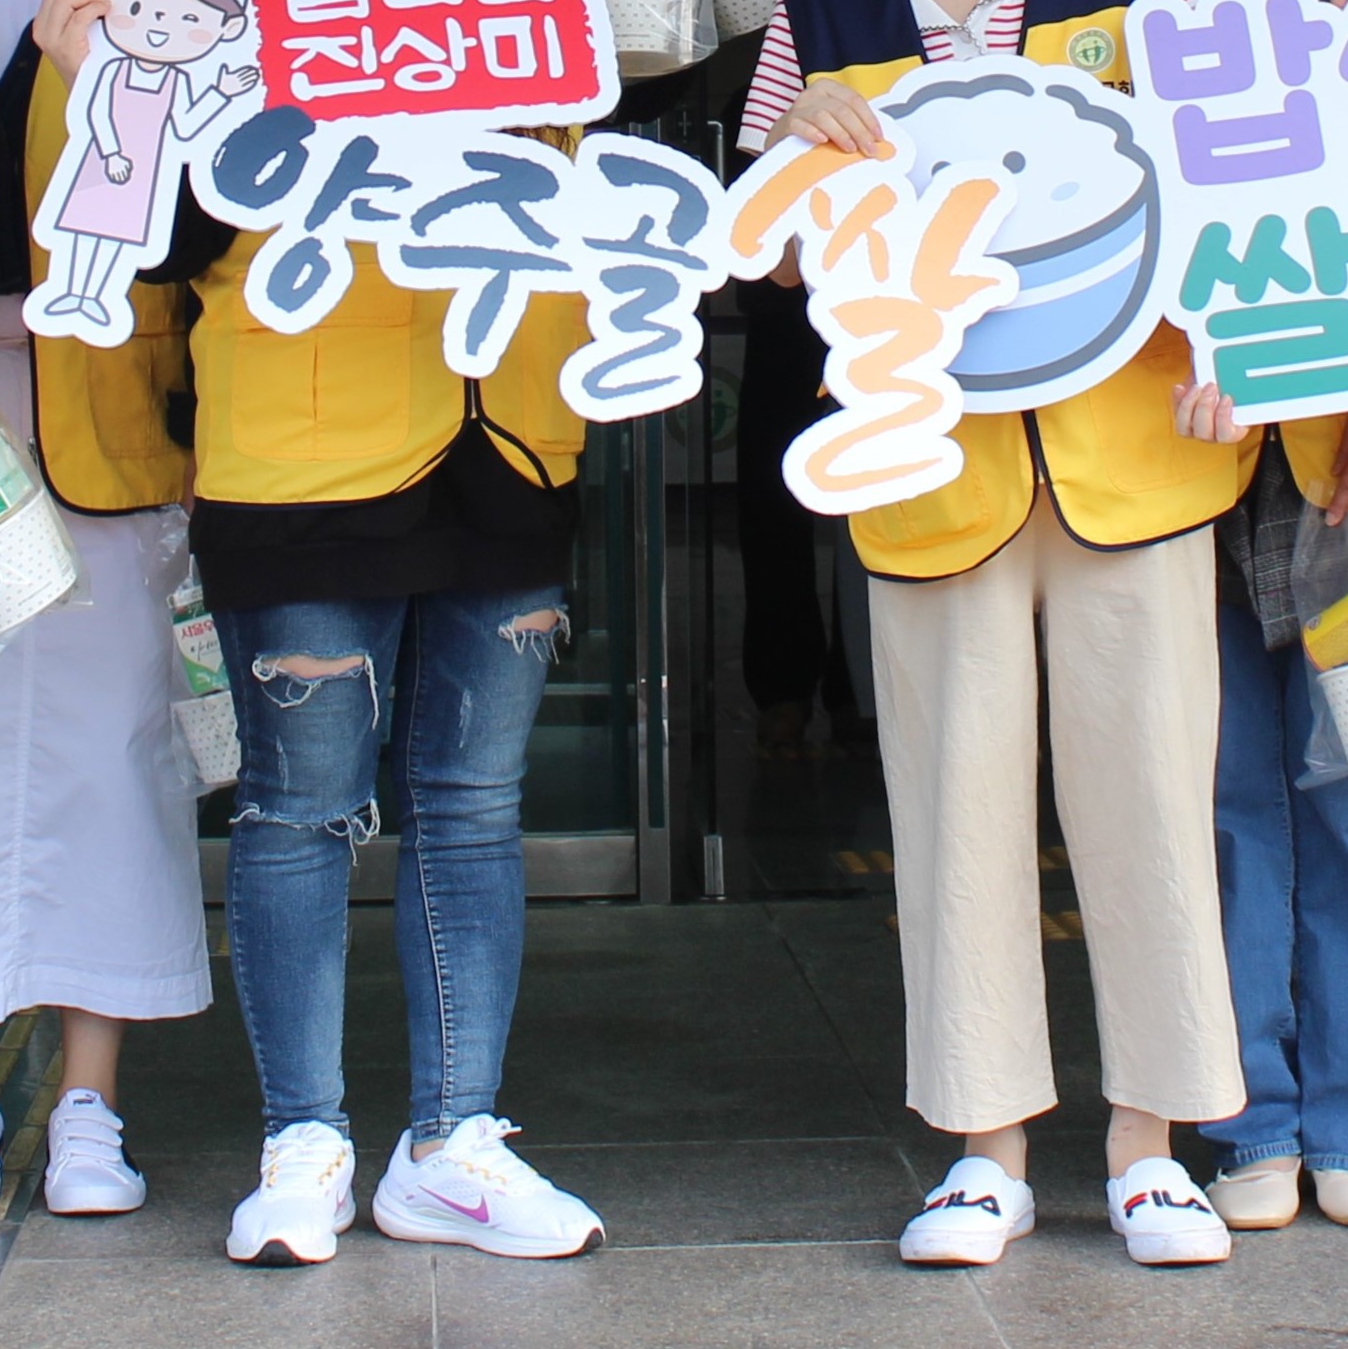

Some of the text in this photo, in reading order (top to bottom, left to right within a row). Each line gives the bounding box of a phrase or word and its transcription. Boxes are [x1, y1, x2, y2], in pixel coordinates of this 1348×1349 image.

[281, 13, 565, 101] 진상미
[211, 104, 710, 401] 양주골
[1124, 1189, 1212, 1218] FILA
